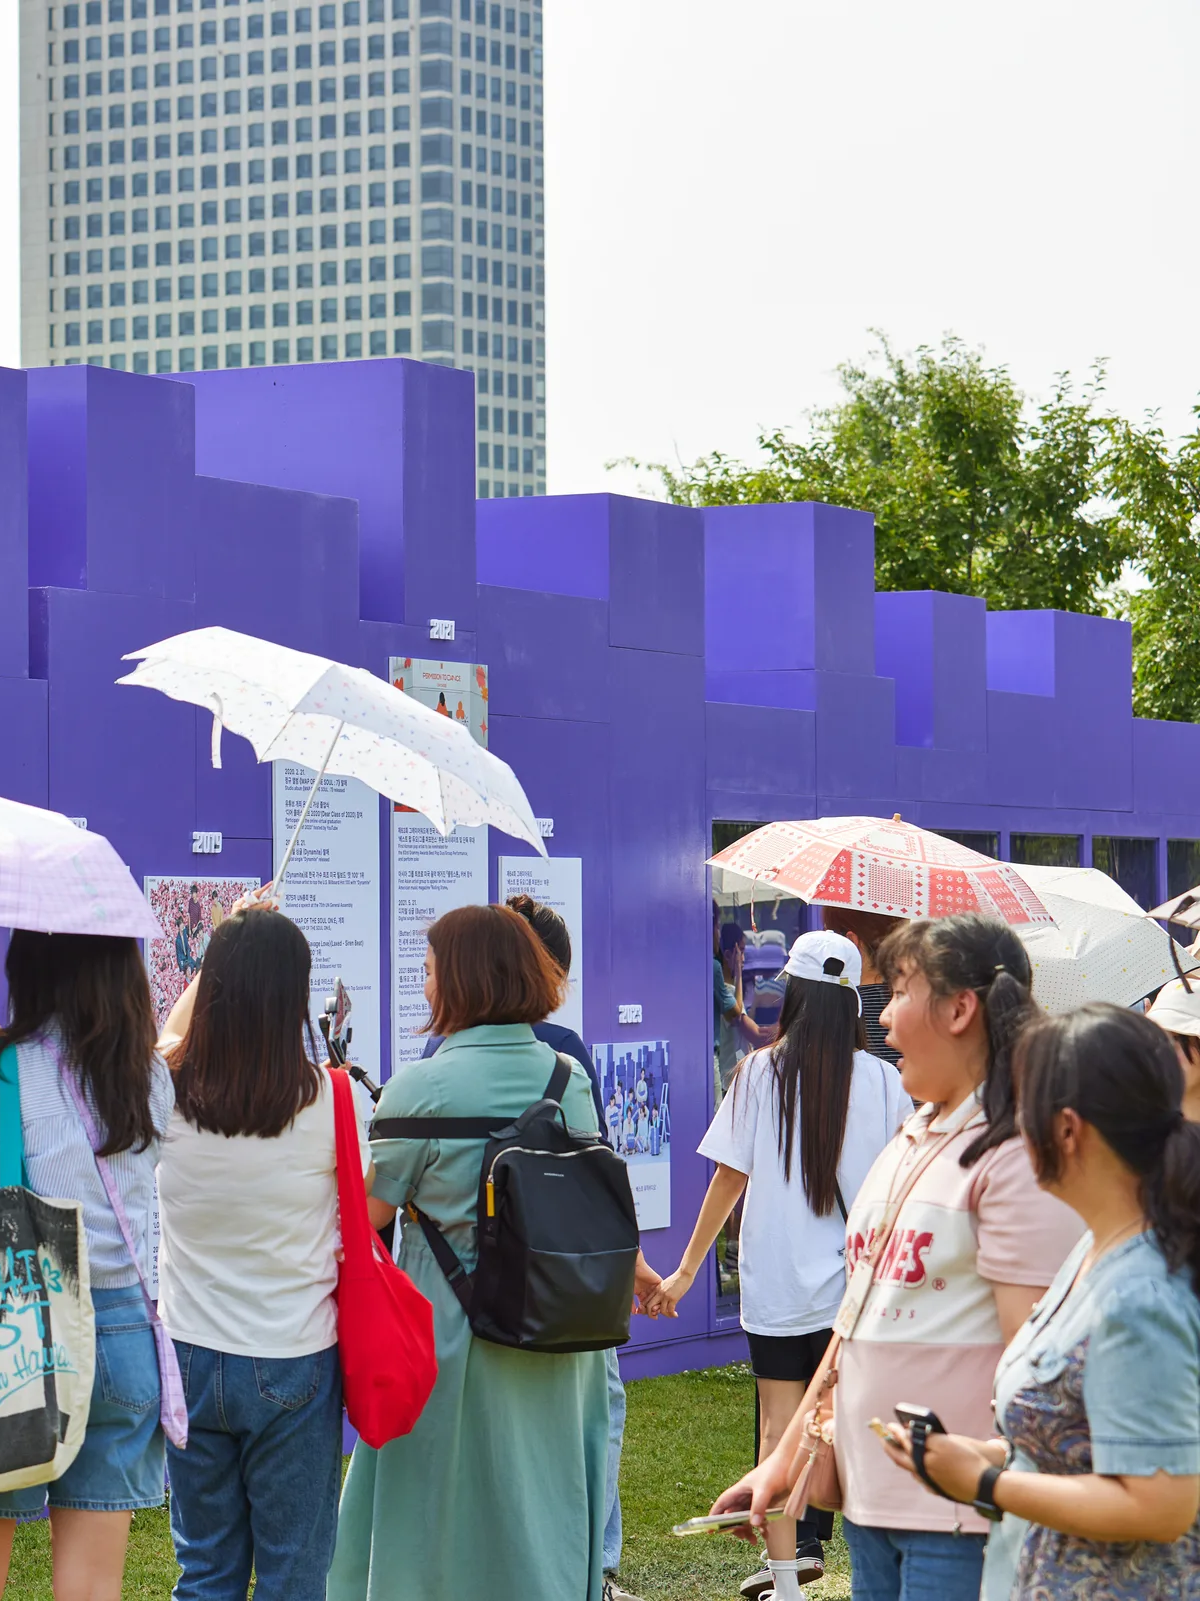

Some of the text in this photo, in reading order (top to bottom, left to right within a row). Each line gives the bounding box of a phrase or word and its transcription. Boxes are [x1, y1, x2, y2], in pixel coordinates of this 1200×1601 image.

[429, 618, 455, 641] 2021
[192, 831, 222, 854] 2019
[618, 1004, 642, 1024] 2023
